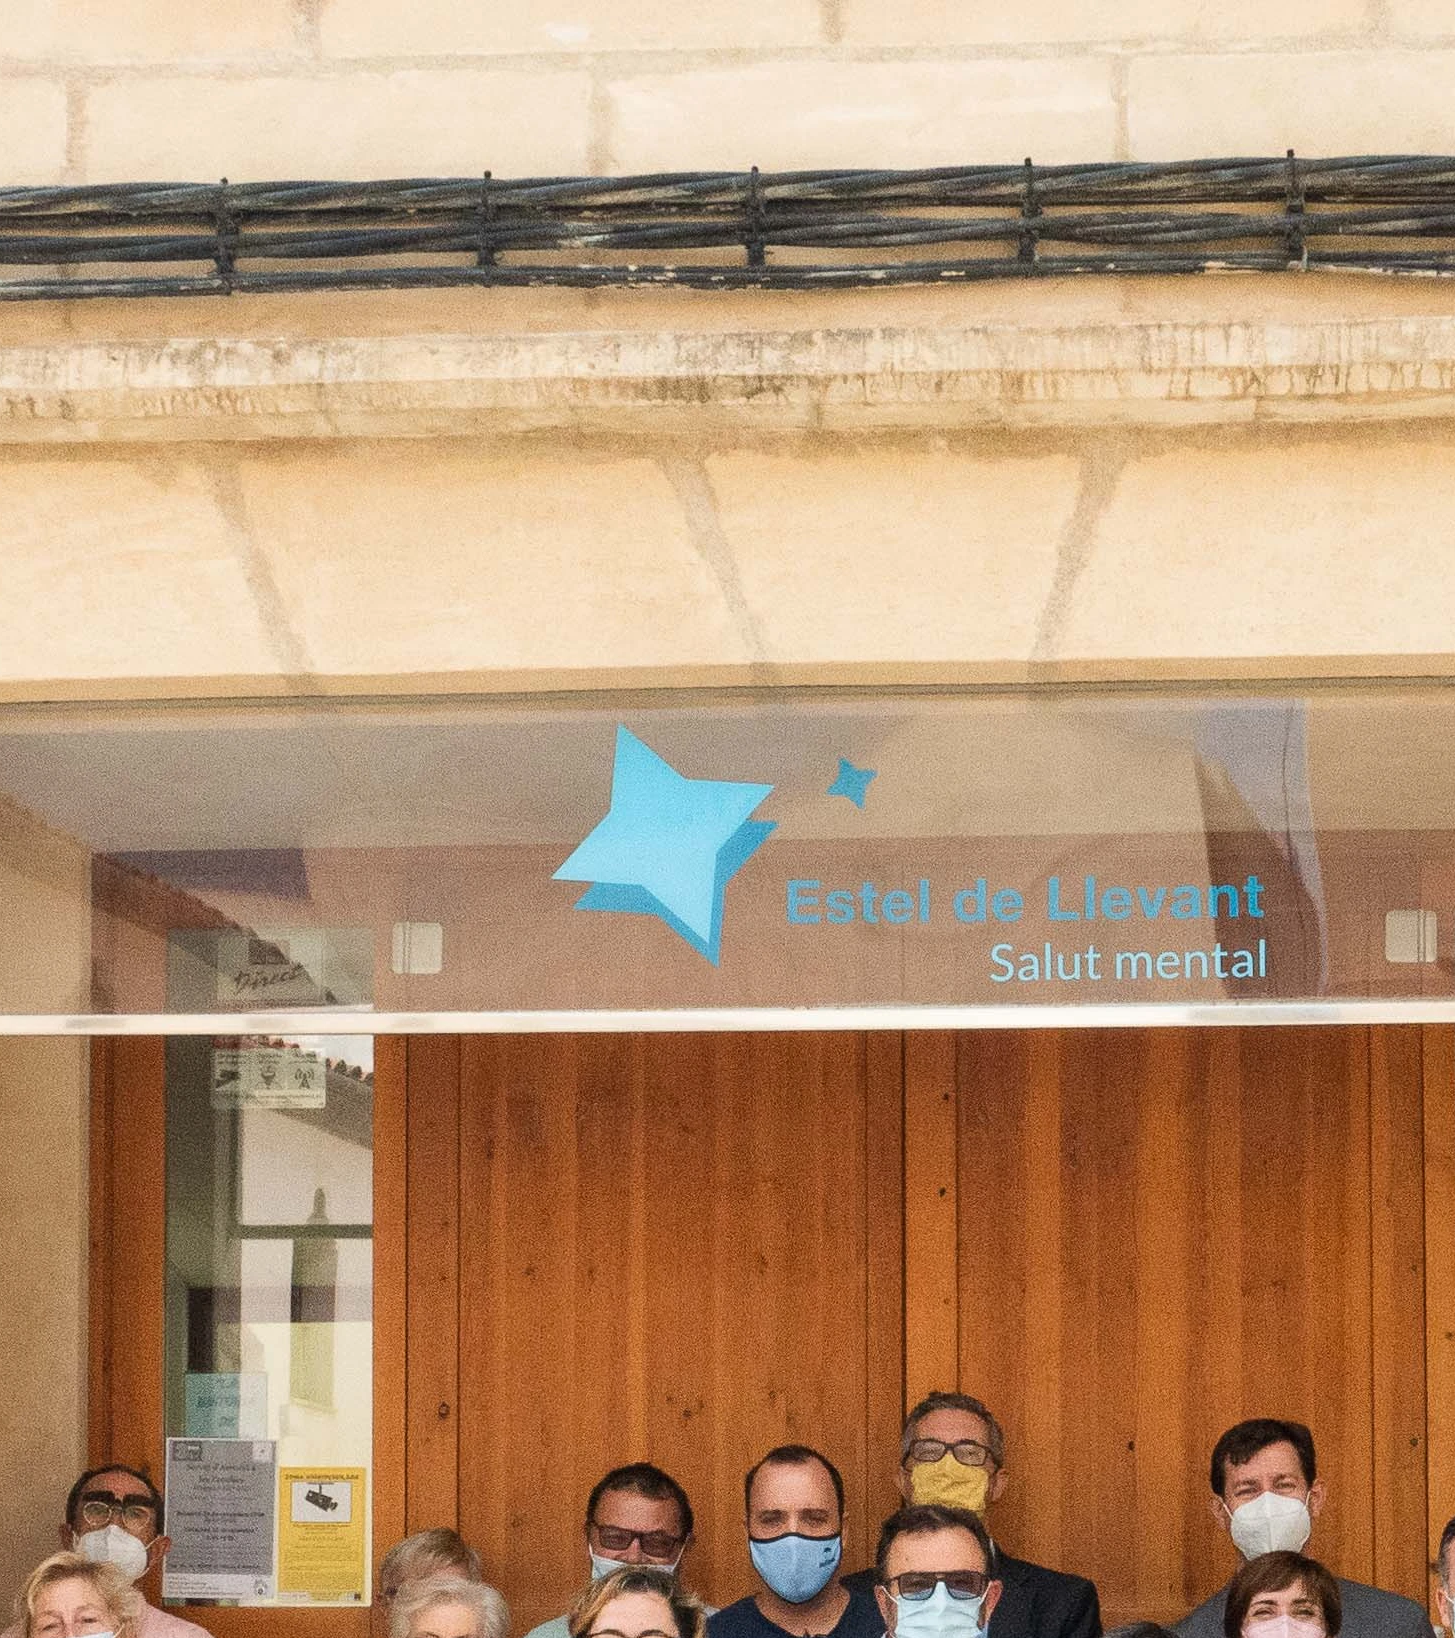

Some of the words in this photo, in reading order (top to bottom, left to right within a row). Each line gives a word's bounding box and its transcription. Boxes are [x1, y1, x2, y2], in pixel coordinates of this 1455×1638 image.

[785, 878, 930, 925] Estel
[953, 879, 1025, 924] de
[1047, 875, 1266, 922] Llevant
[989, 942, 1102, 984] Salut
[1115, 939, 1268, 981] mental
